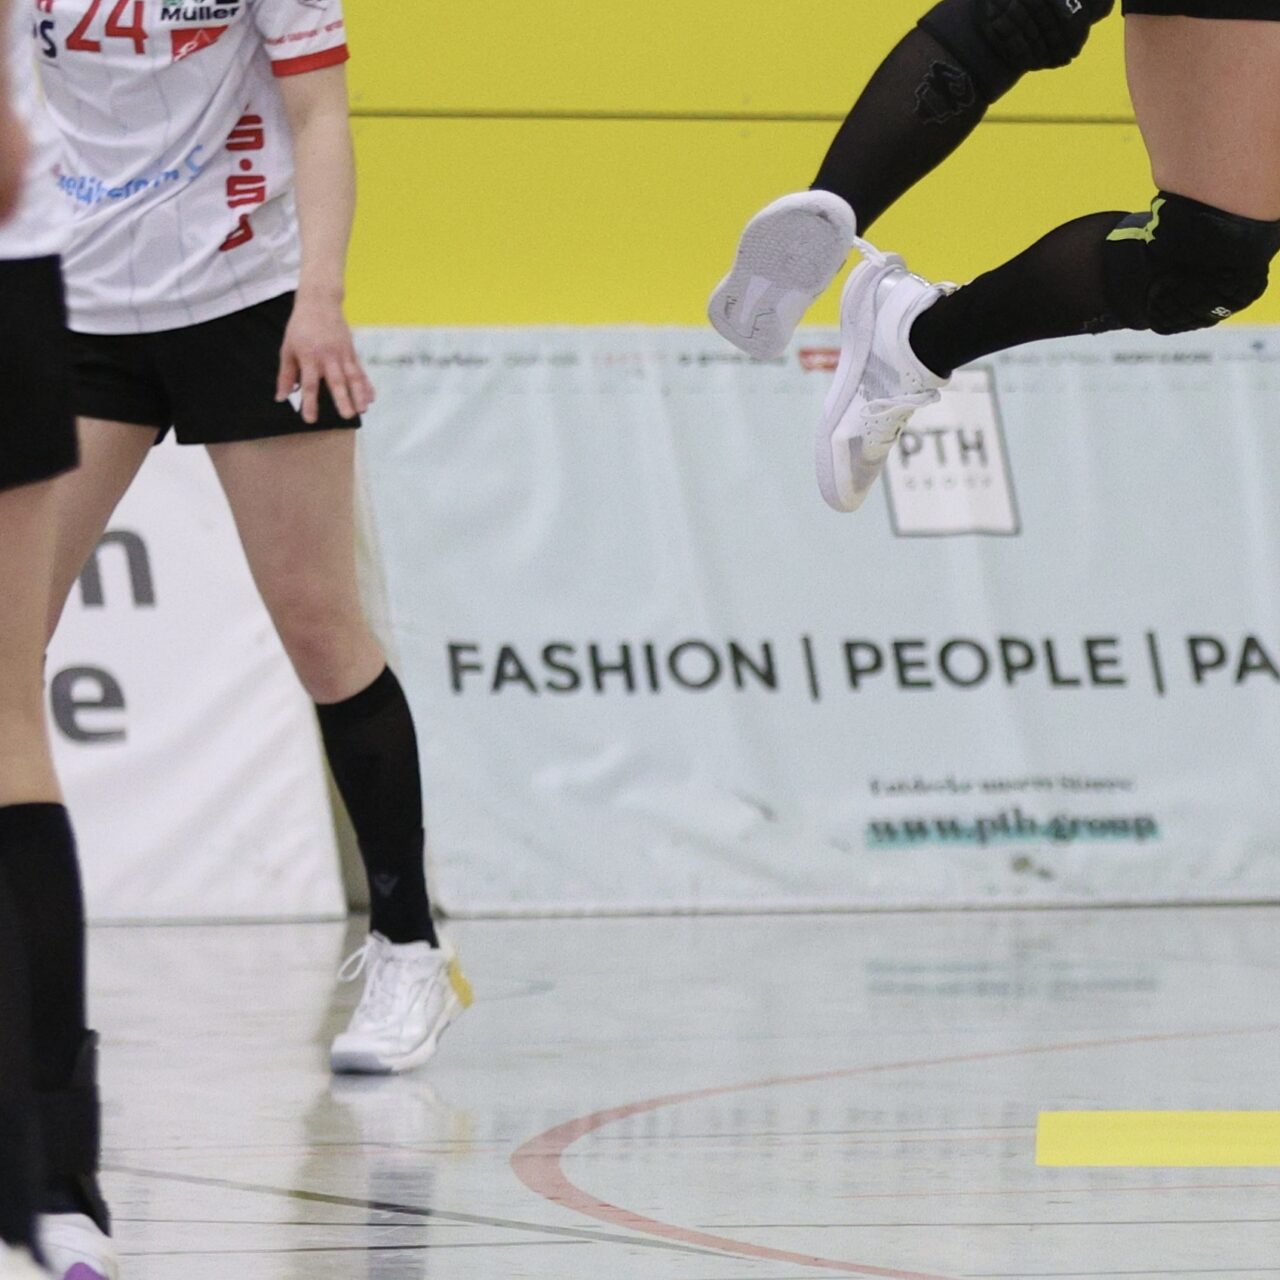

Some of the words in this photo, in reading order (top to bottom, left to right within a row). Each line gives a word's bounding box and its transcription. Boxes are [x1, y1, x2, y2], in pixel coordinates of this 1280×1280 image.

[160, 4, 241, 22] Müller
[899, 429, 989, 469] PTH
[446, 640, 780, 694] FASHION
[842, 636, 1126, 691] PEOPLE
